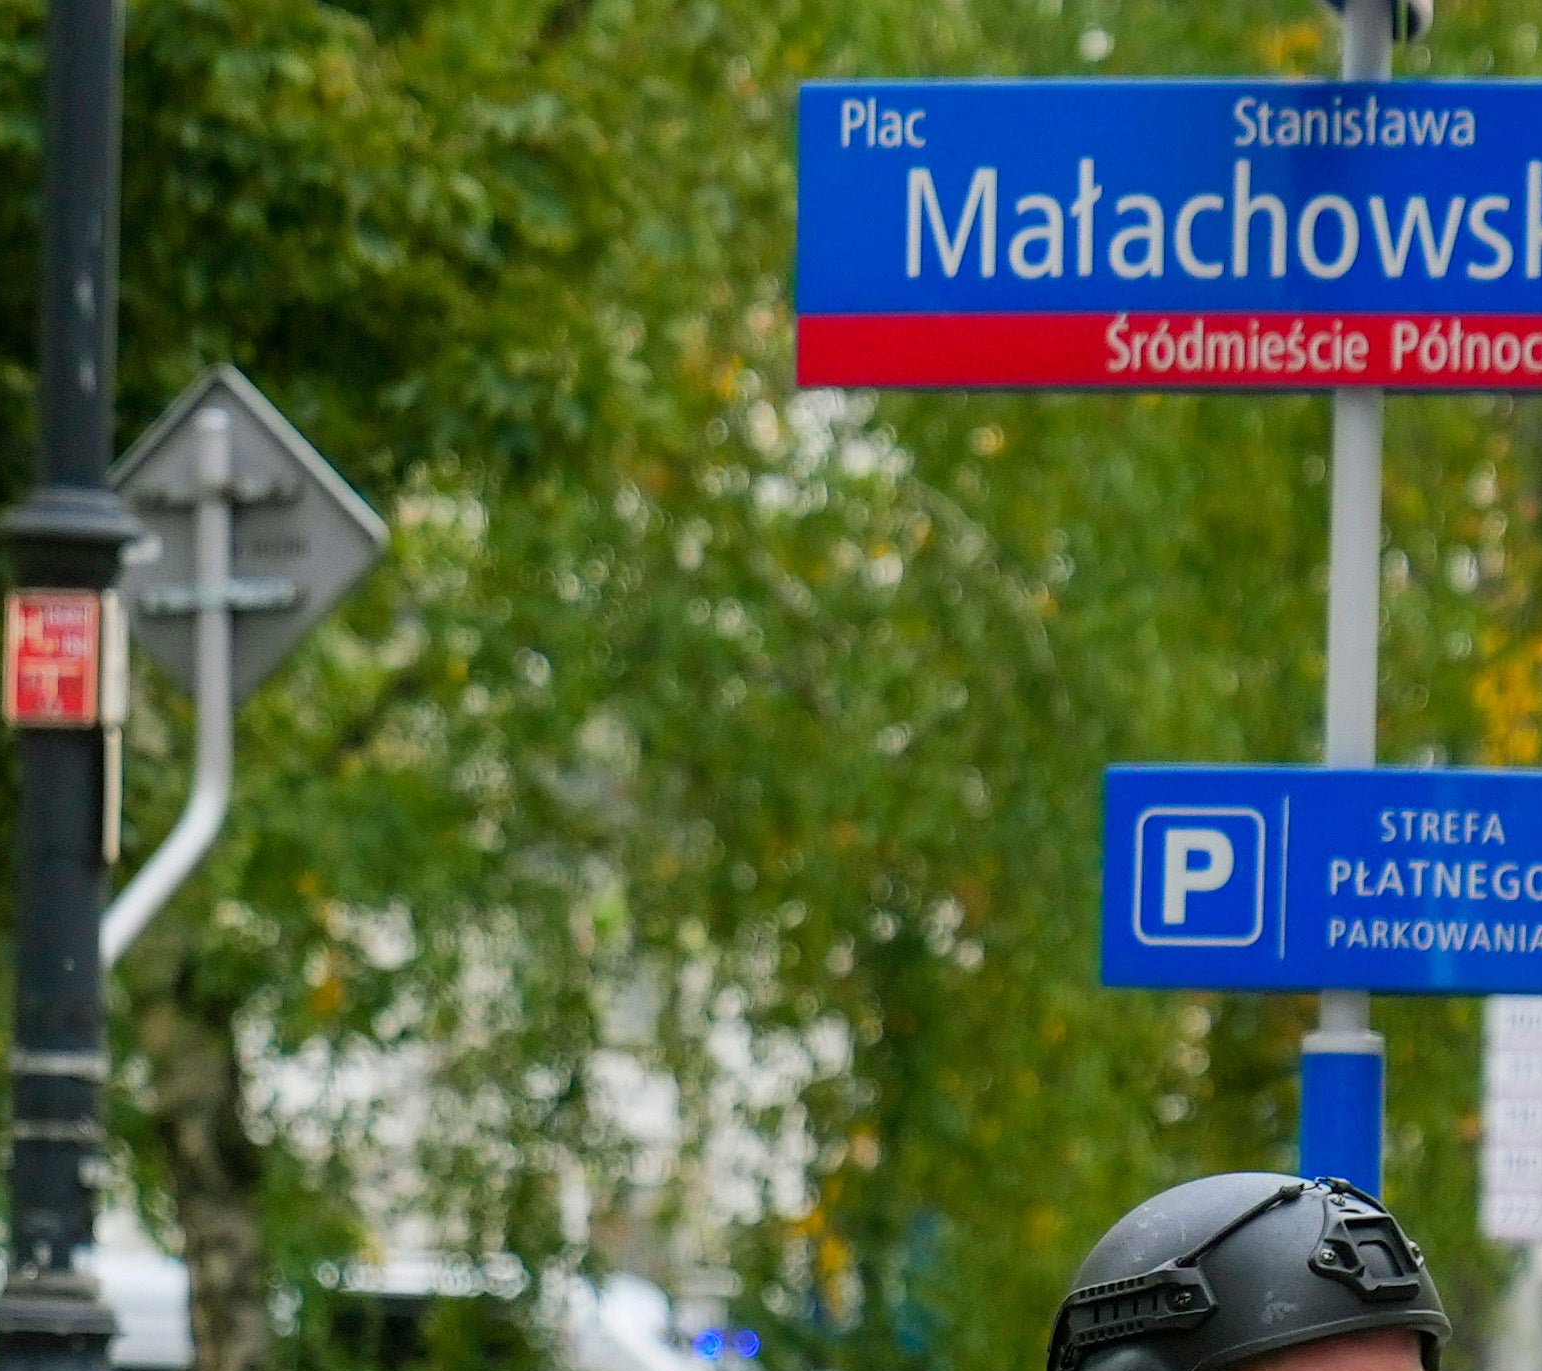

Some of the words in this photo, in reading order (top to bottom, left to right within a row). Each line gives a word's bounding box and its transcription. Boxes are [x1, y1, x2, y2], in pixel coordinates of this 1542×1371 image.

[842, 98, 925, 148] Plac
[1234, 97, 1474, 146] Stanisława
[1106, 312, 1369, 372] Śródmieście
[1380, 810, 1505, 844] STREFA
[1162, 828, 1234, 925] P
